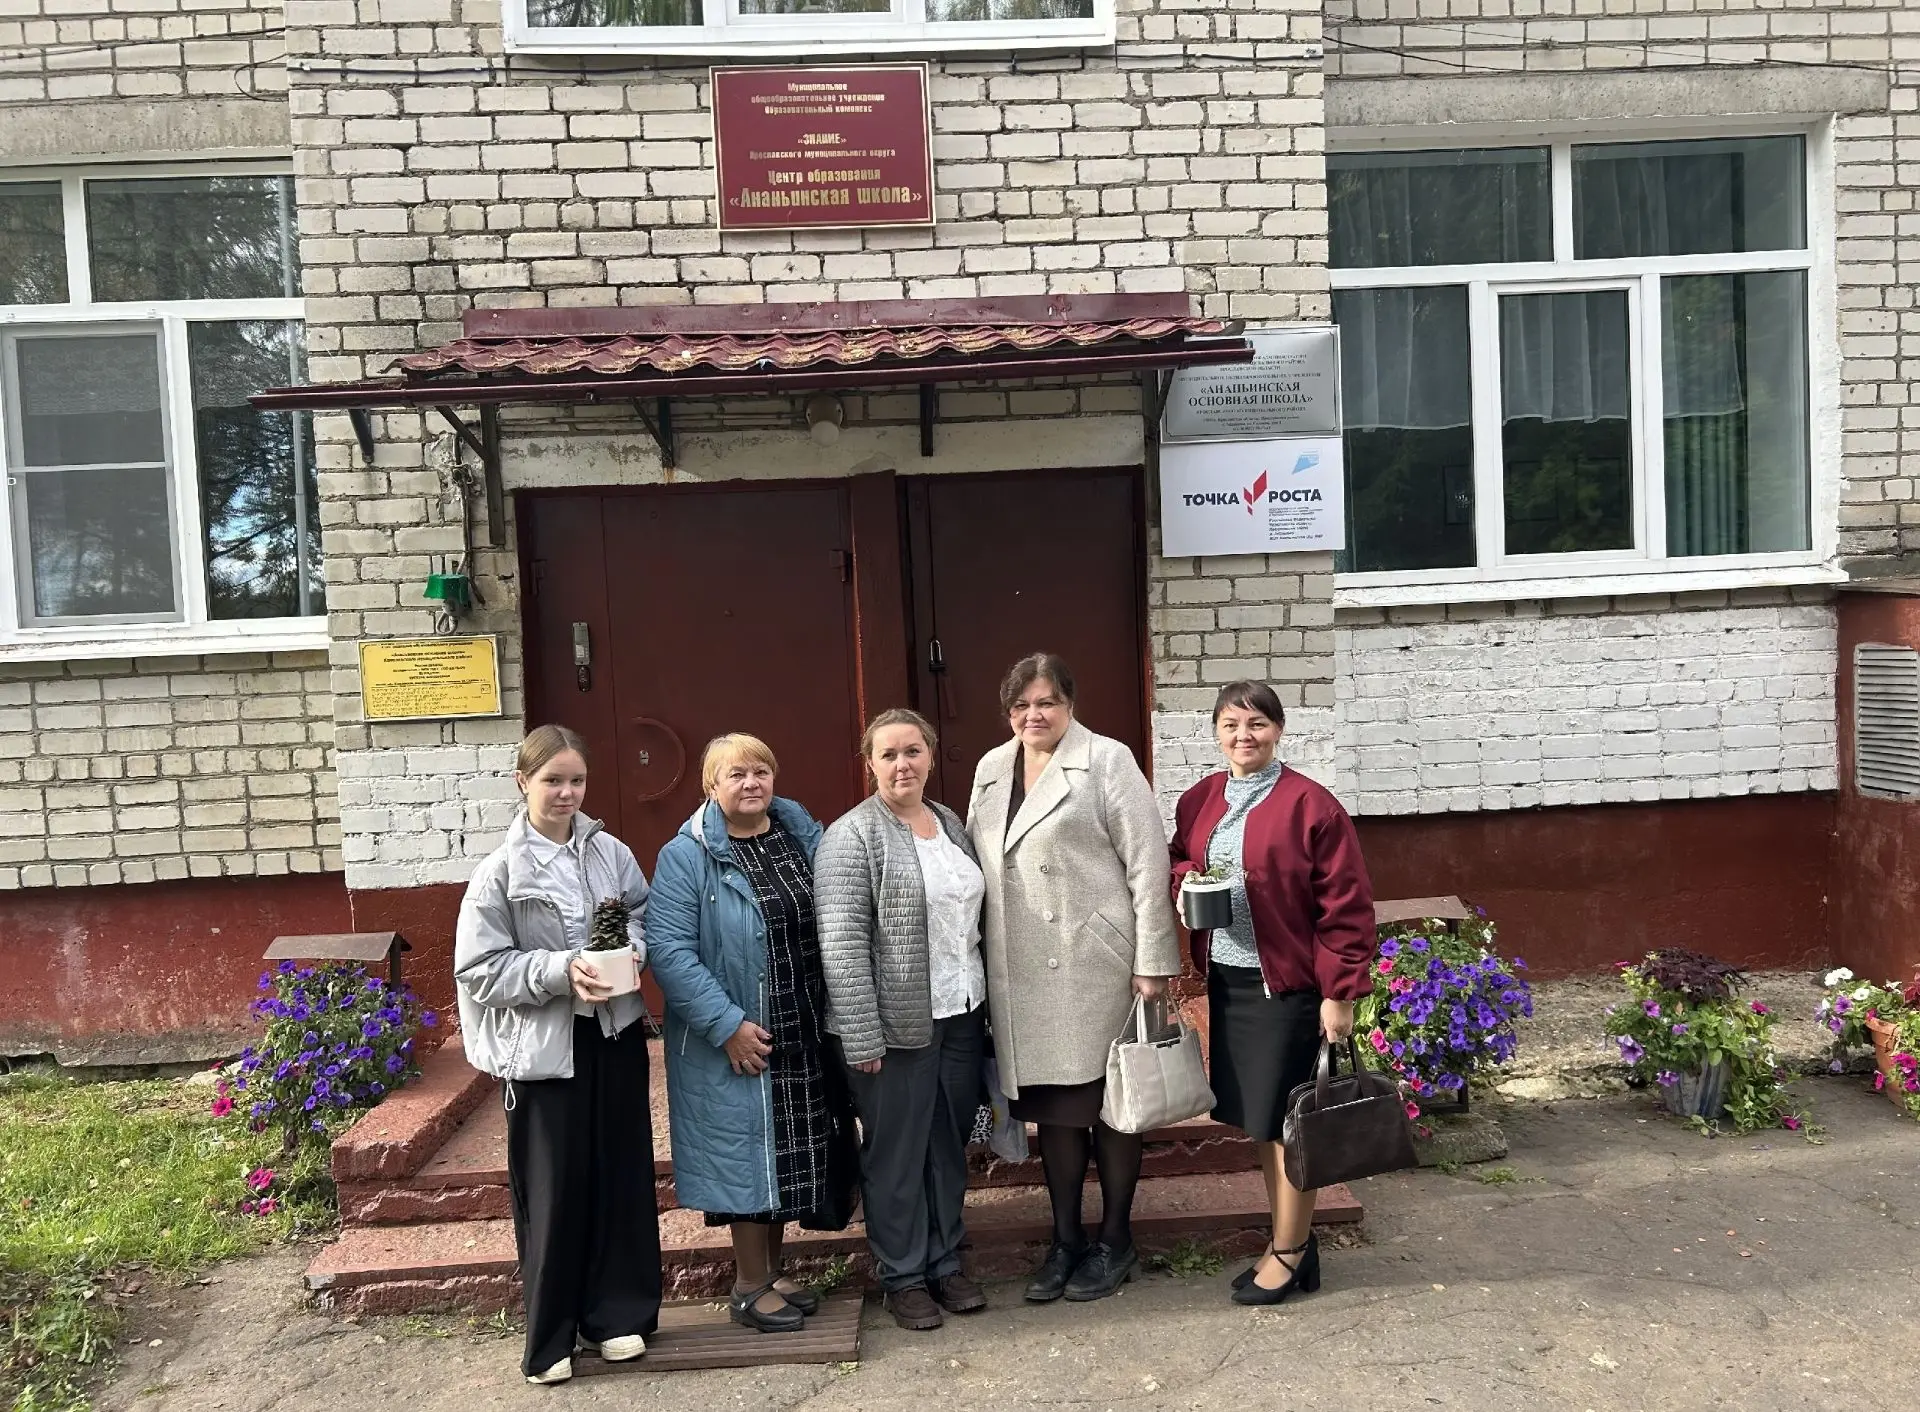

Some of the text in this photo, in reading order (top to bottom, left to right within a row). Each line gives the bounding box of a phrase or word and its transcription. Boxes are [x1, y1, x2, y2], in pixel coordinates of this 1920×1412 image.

[768, 168, 881, 186] Центр образования
[729, 186, 922, 208] «Ананьинская школа»
[1188, 393, 1313, 407] ОСНОВНАЯ ШКОЛА»
[1182, 488, 1323, 507] ТОЧКА РОСТА
